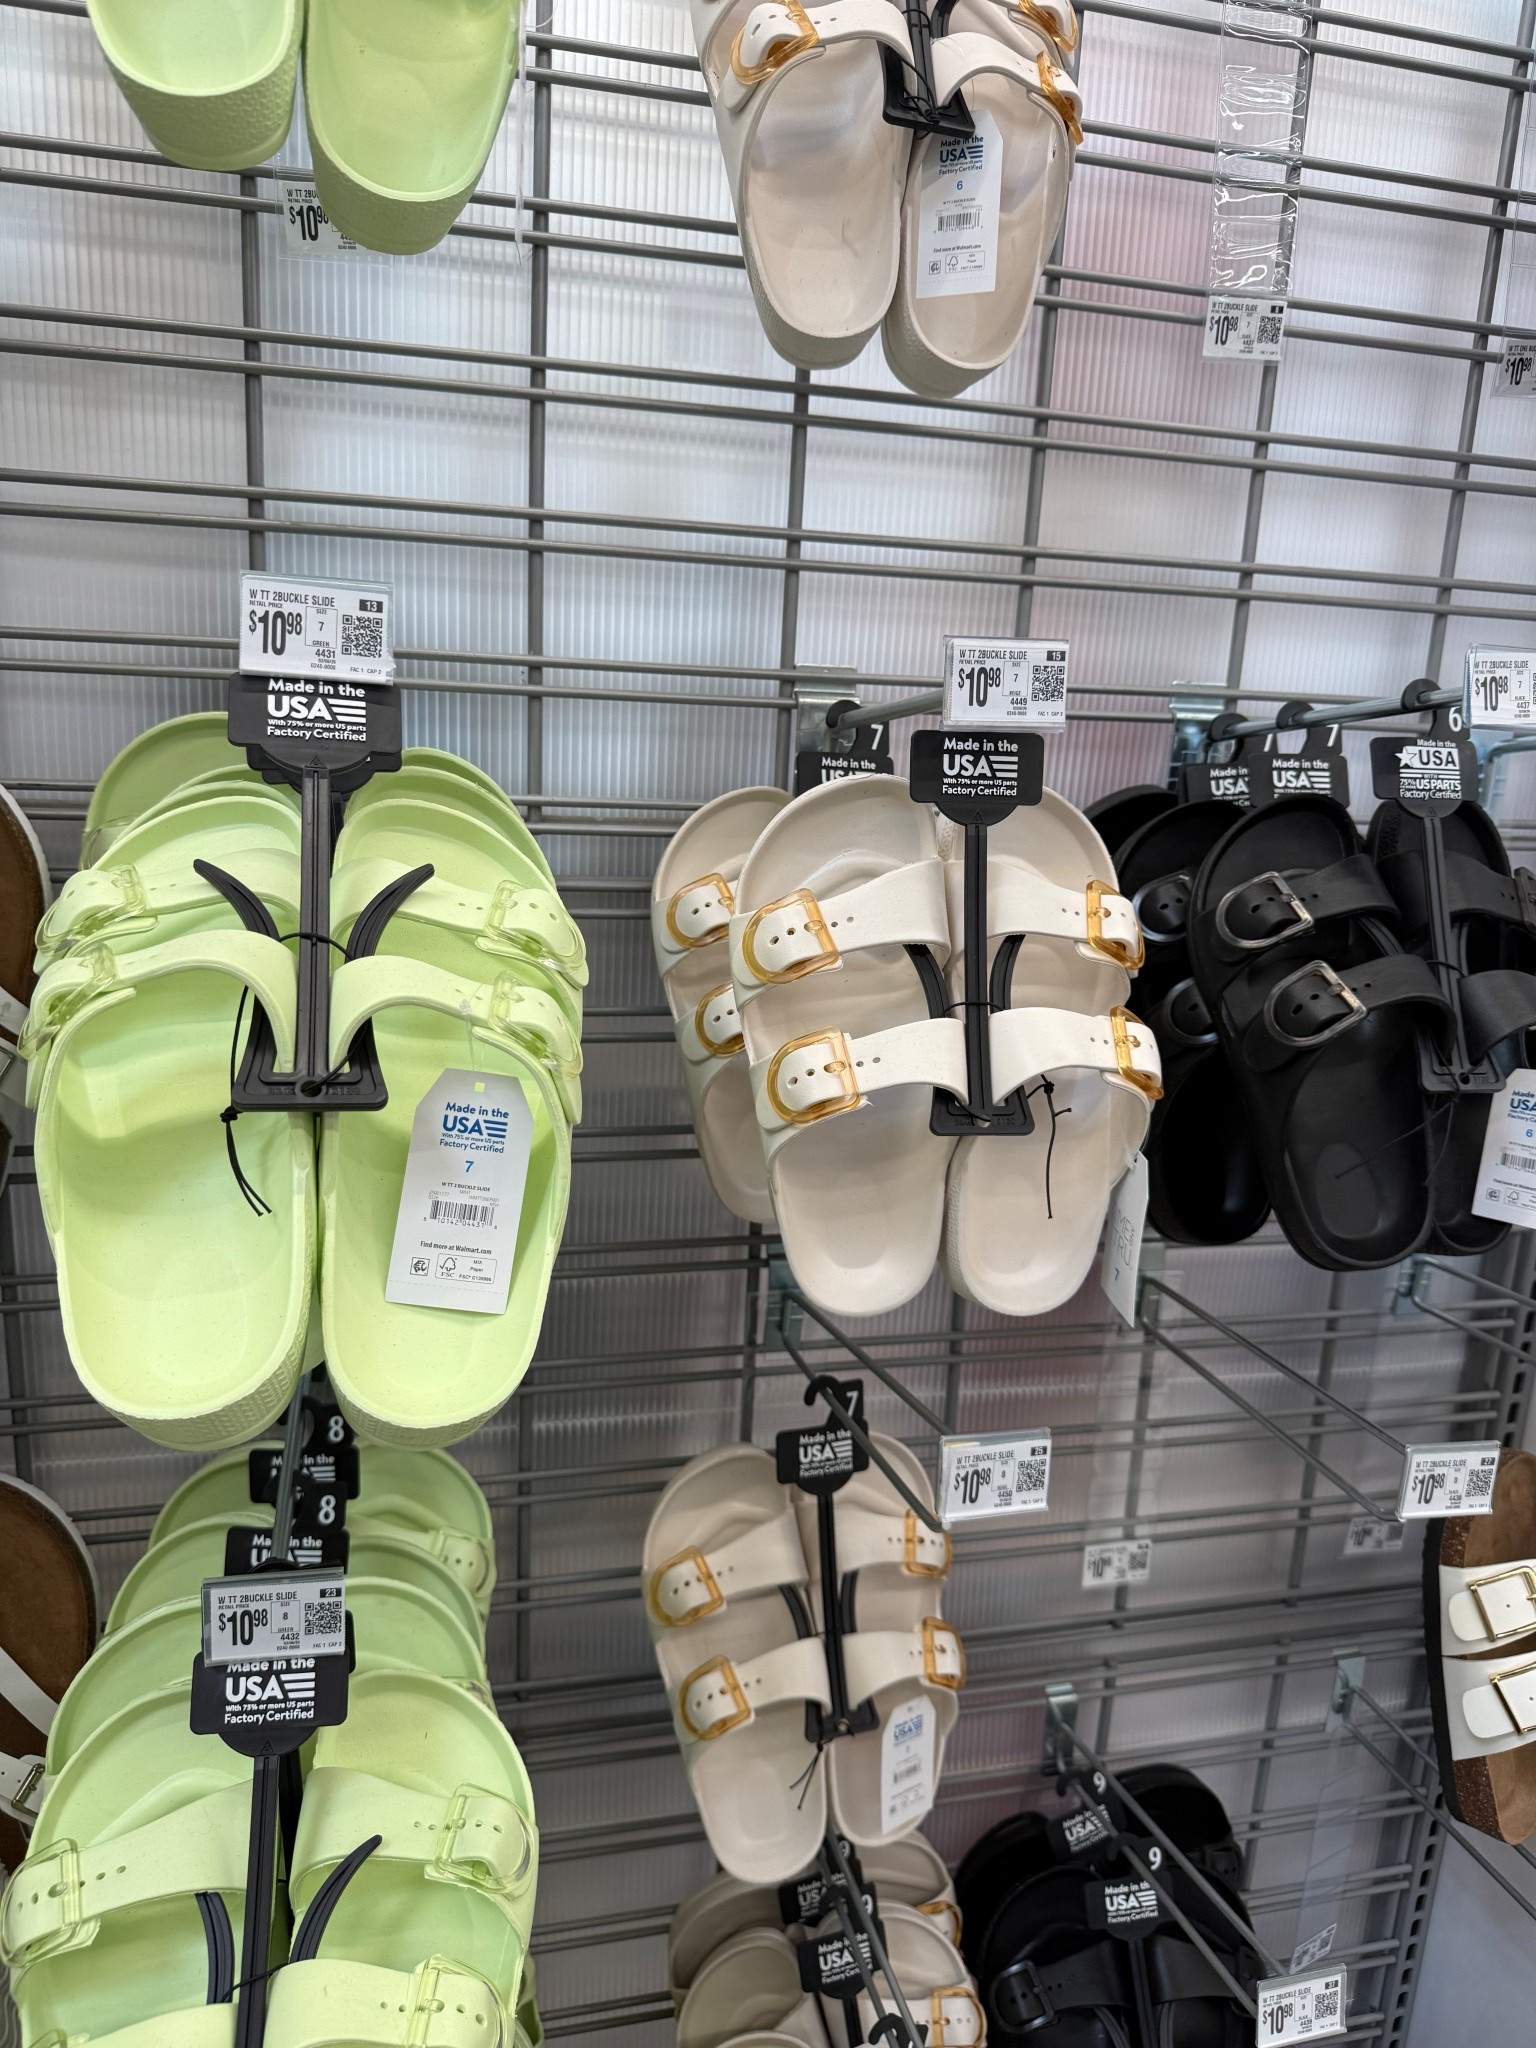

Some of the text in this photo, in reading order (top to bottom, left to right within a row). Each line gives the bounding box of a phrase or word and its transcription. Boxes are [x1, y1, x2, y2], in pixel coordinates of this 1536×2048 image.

[940, 148, 967, 163] USA
[939, 167, 958, 175] Factory
[957, 181, 963, 190] 6
[287, 189, 302, 198] W TT
[1224, 303, 1244, 311] 2BUCKLE
[249, 589, 335, 607] W TT 2BUCKLE SLIDE
[366, 602, 377, 611] 13
[319, 622, 324, 631] 7
[315, 649, 336, 659] 4431
[960, 649, 1027, 660] W TT 2BUCKLE SLIDE
[1052, 652, 1061, 660] 15
[1482, 661, 1488, 669] TT
[1489, 661, 1512, 669] 2BUCKLE
[1014, 674, 1018, 682] 7
[268, 678, 365, 698] Made in the
[267, 695, 332, 721] USA
[1010, 698, 1027, 706] 4449
[1449, 706, 1462, 732] 6
[267, 727, 366, 741] Factory Certified
[870, 724, 884, 750] 7
[1326, 724, 1339, 747] 7
[943, 737, 1018, 752] Made in the
[822, 756, 876, 770] Made in the
[1272, 758, 1329, 769] Made in the
[1419, 749, 1457, 767] USA
[943, 754, 992, 777] USA
[1210, 766, 1248, 778] Made in
[1272, 770, 1310, 788] USA
[1416, 779, 1461, 790] US PARTS
[942, 785, 1016, 797] Factory Certified
[1210, 778, 1249, 796] USA
[1400, 789, 1461, 800] Factory Certified
[1512, 1090, 1535, 1098] Made
[445, 1101, 509, 1118] Made in the
[442, 1114, 483, 1135] USA
[1526, 1129, 1533, 1137] 6
[440, 1139, 504, 1153] Factory Certified
[466, 1160, 474, 1172] 7
[455, 1245, 492, 1255] Walmart.com
[846, 1391, 859, 1416] 7
[329, 1415, 345, 1443] 8
[800, 1432, 825, 1445] Made
[799, 1443, 835, 1462] USA
[972, 1452, 997, 1463] 2BUCKLE
[998, 1450, 1014, 1459] SLIDE
[1035, 1447, 1042, 1455] 25
[316, 1453, 335, 1464] the
[318, 1495, 336, 1525] 8
[289, 1536, 322, 1547] in the
[218, 1591, 297, 1605] W TT 2BUCKLE SLIDE
[283, 1612, 288, 1620] 8
[280, 1633, 300, 1641] 4432
[290, 1658, 315, 1669] the
[226, 1674, 284, 1703] USA
[224, 1708, 314, 1725] Factory Certified
[1093, 1771, 1107, 1794] 9
[1064, 1819, 1096, 1841] USA
[1149, 1846, 1162, 1871] 9
[1105, 1893, 1140, 1911] USA
[818, 1939, 844, 1954] Made
[819, 1947, 853, 1971] USA
[1276, 1987, 1311, 2000] 2BUCKLE SLIDE
